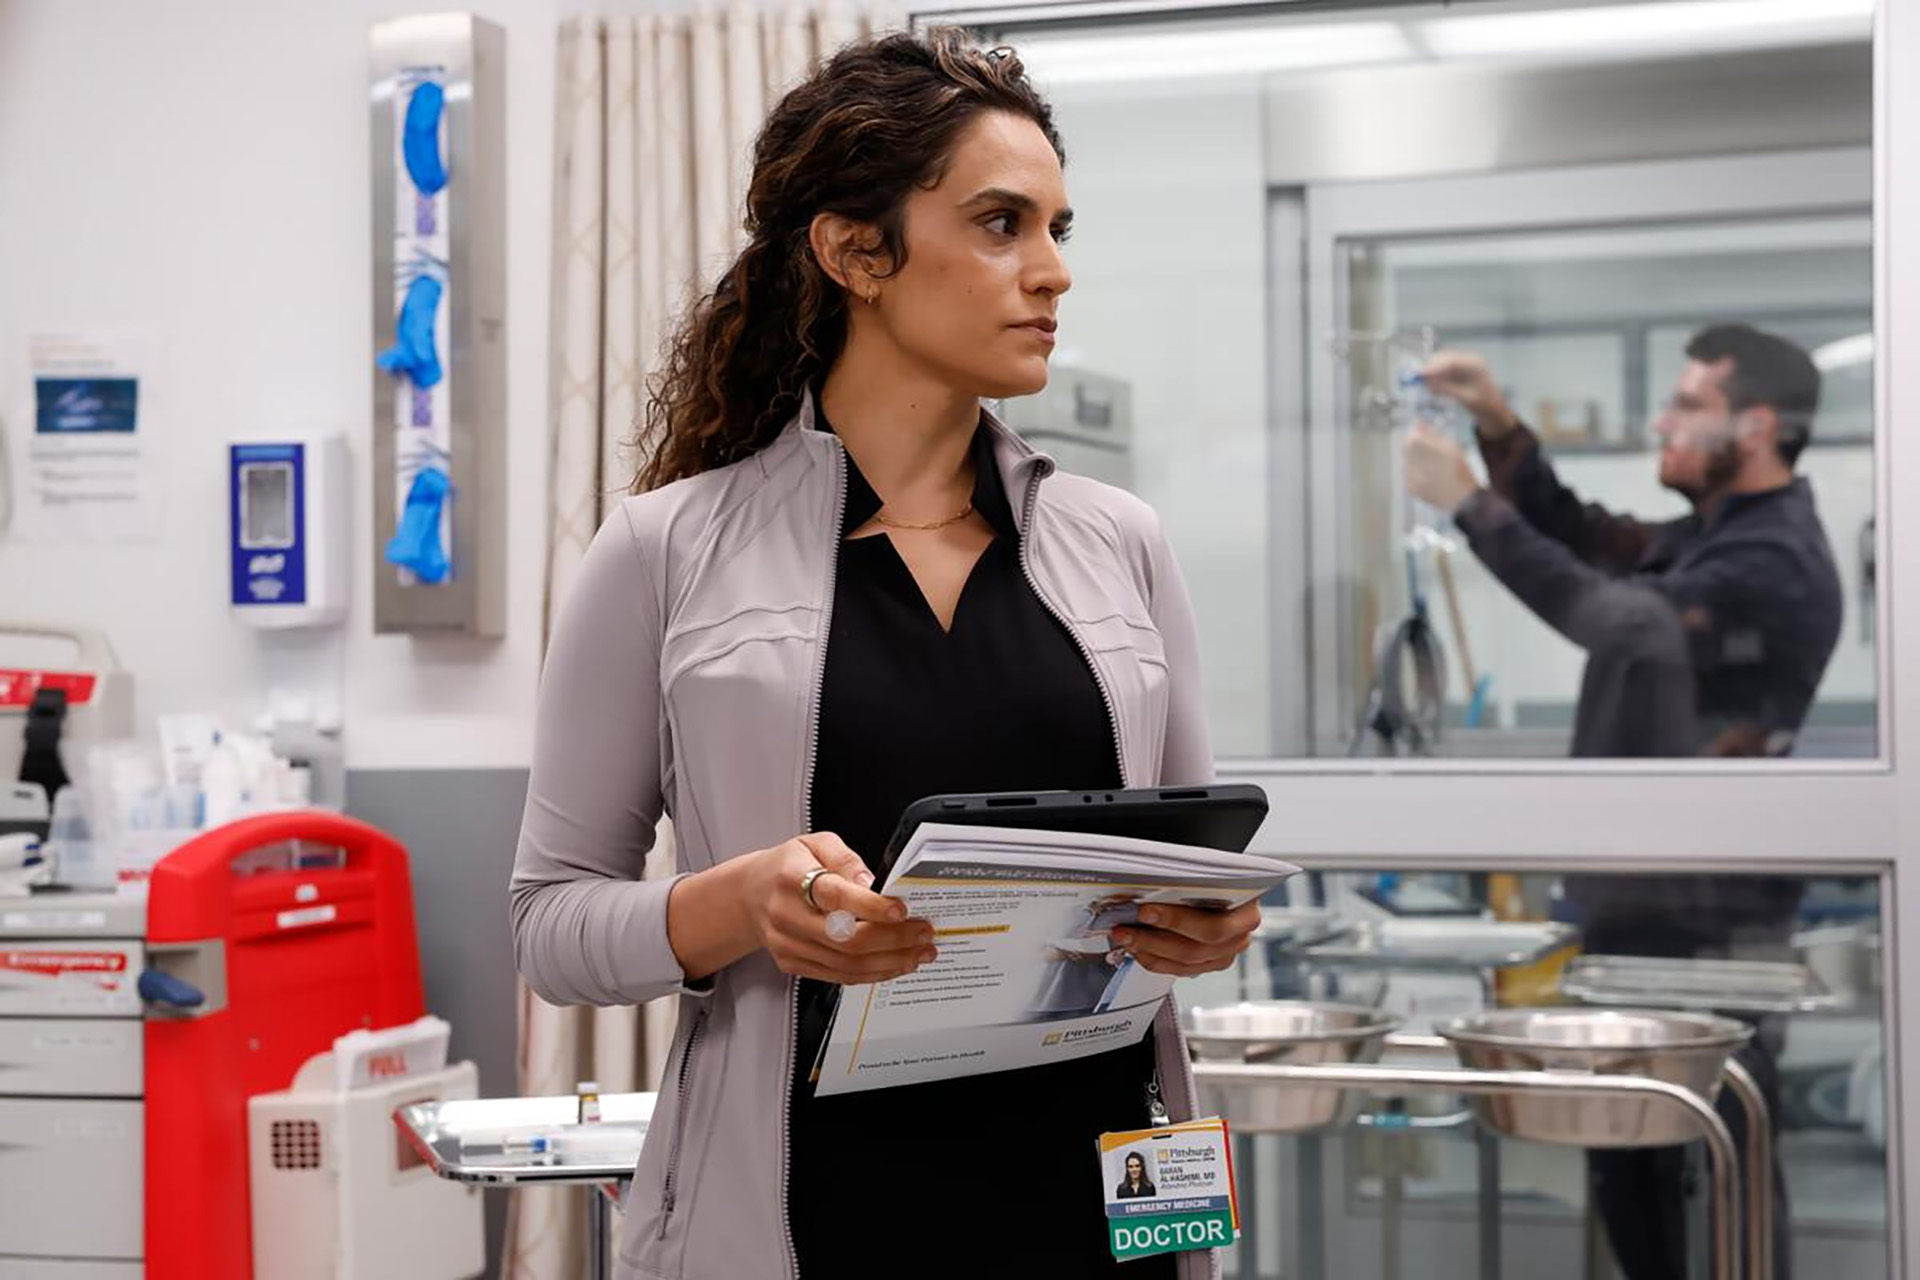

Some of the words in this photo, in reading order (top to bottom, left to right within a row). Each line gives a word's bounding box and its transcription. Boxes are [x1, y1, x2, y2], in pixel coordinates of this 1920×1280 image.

[1125, 1201, 1172, 1214] EMERGENCY
[1173, 1198, 1211, 1211] MEDICINE
[1115, 1219, 1225, 1251] DOCTOR
